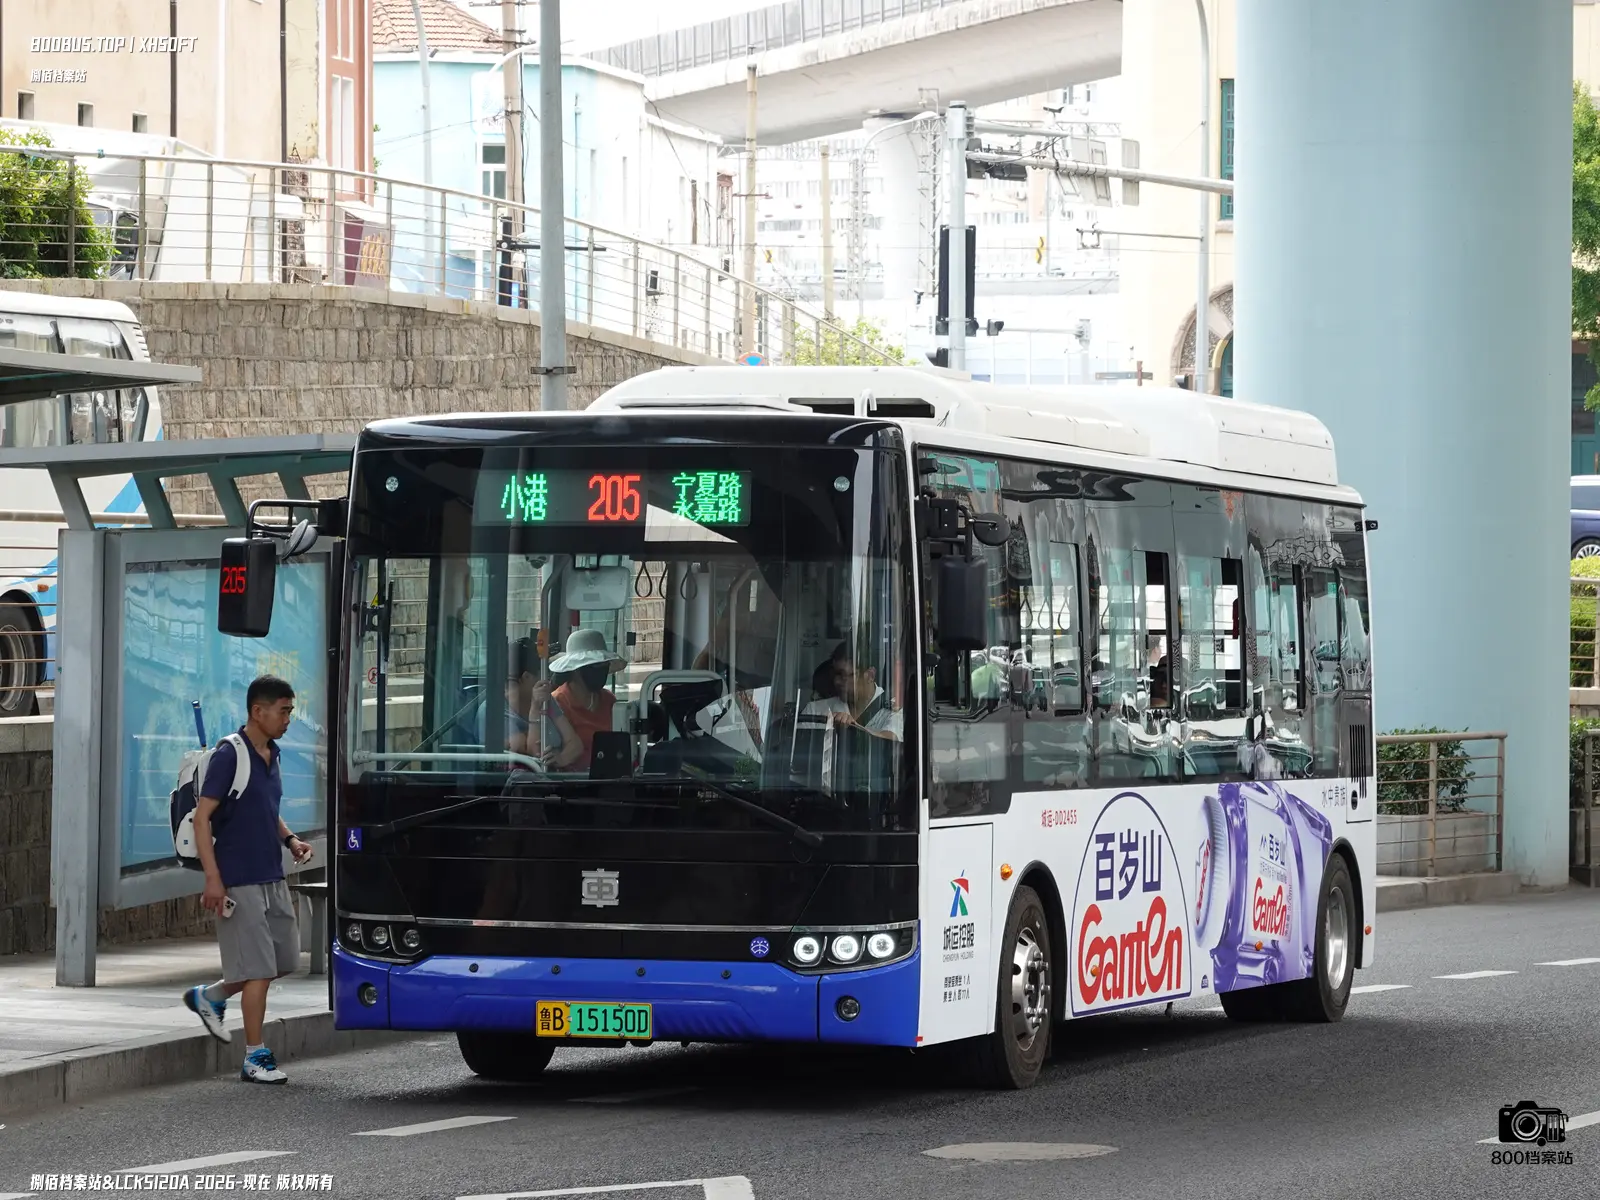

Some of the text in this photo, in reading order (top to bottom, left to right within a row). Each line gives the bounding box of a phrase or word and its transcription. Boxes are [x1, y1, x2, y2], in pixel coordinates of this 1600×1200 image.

[500, 473, 548, 521] 小港
[588, 474, 641, 521] 205
[672, 472, 742, 498] 宁夏路
[672, 497, 742, 523] 永嘉路
[221, 566, 247, 594] 205
[1095, 828, 1162, 901] 百岁山
[943, 922, 975, 951] 城运控股
[1078, 896, 1183, 1005] Ganten
[540, 1007, 649, 1033] 鲁B 15150D
